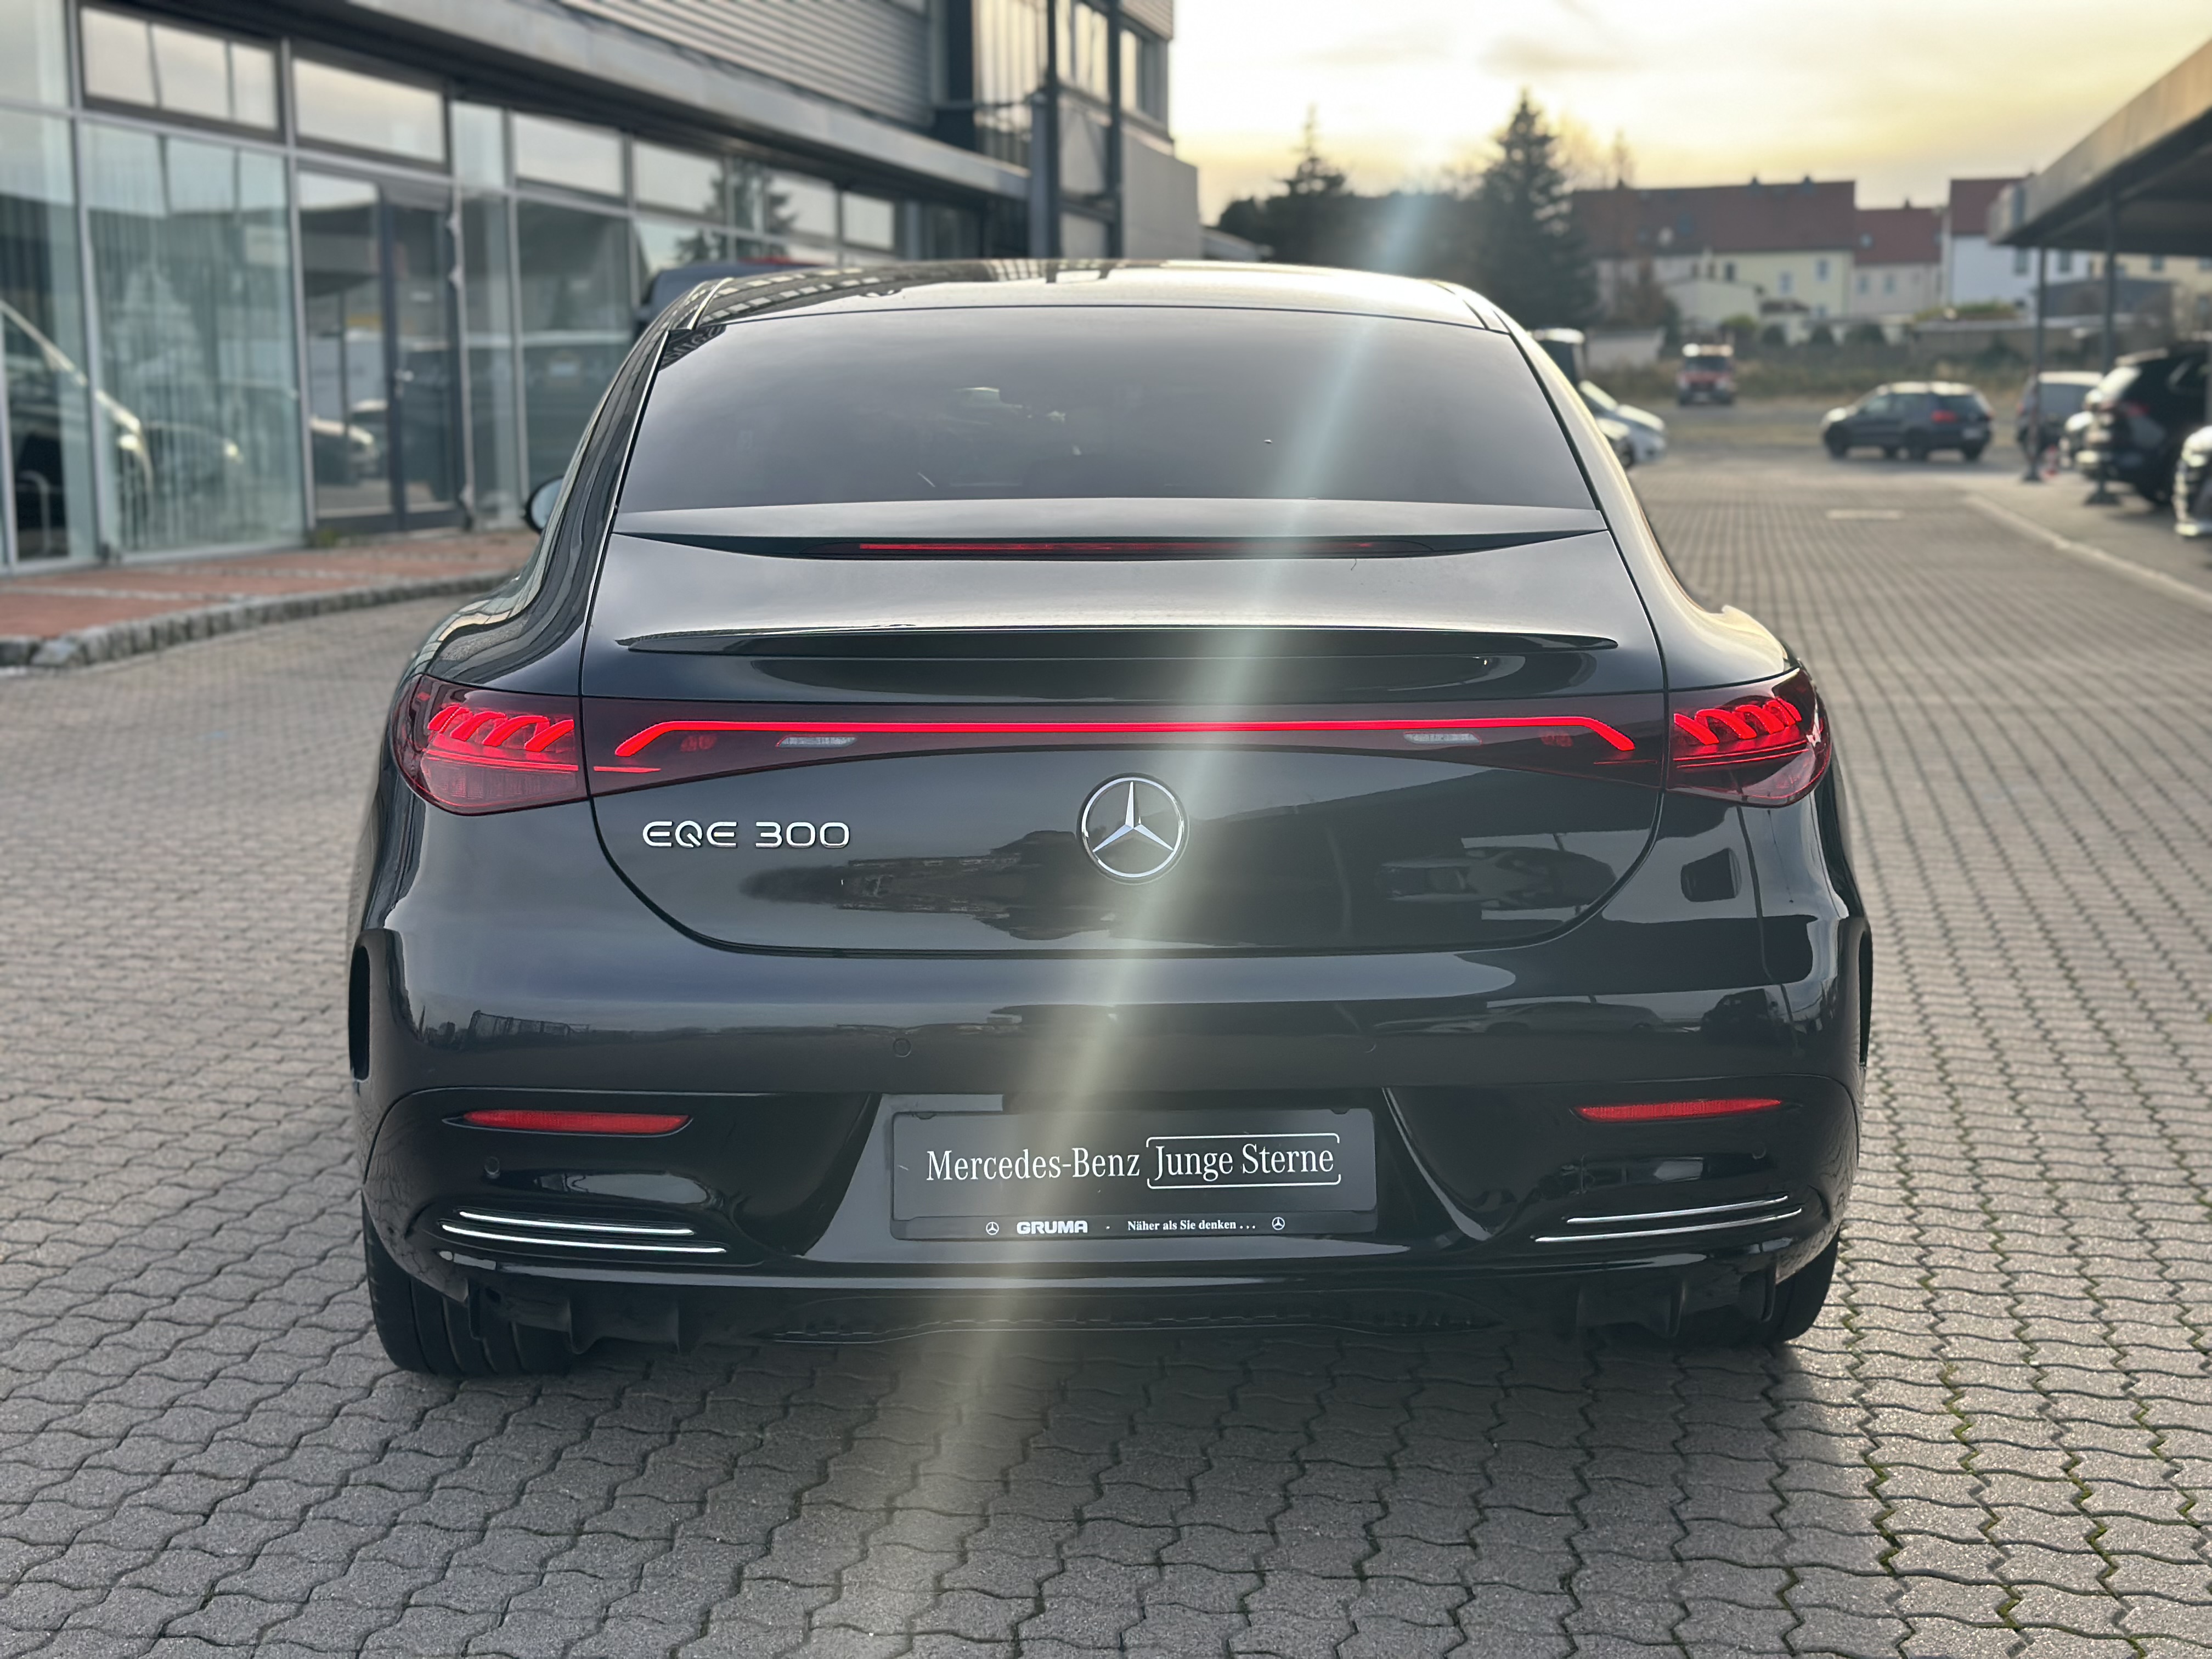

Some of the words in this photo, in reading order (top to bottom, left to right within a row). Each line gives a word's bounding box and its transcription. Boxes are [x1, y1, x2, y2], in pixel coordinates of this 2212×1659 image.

[642, 821, 737, 848] EQE
[755, 822, 849, 848] 300
[927, 1148, 1140, 1181] Mercedes-Benz
[1154, 1145, 1233, 1182] Junge
[1242, 1143, 1334, 1174] Sterne
[1017, 1221, 1088, 1234] GRUMA
[1127, 1221, 1160, 1231] Näher
[1163, 1221, 1177, 1230] als
[1180, 1220, 1196, 1230] Sie
